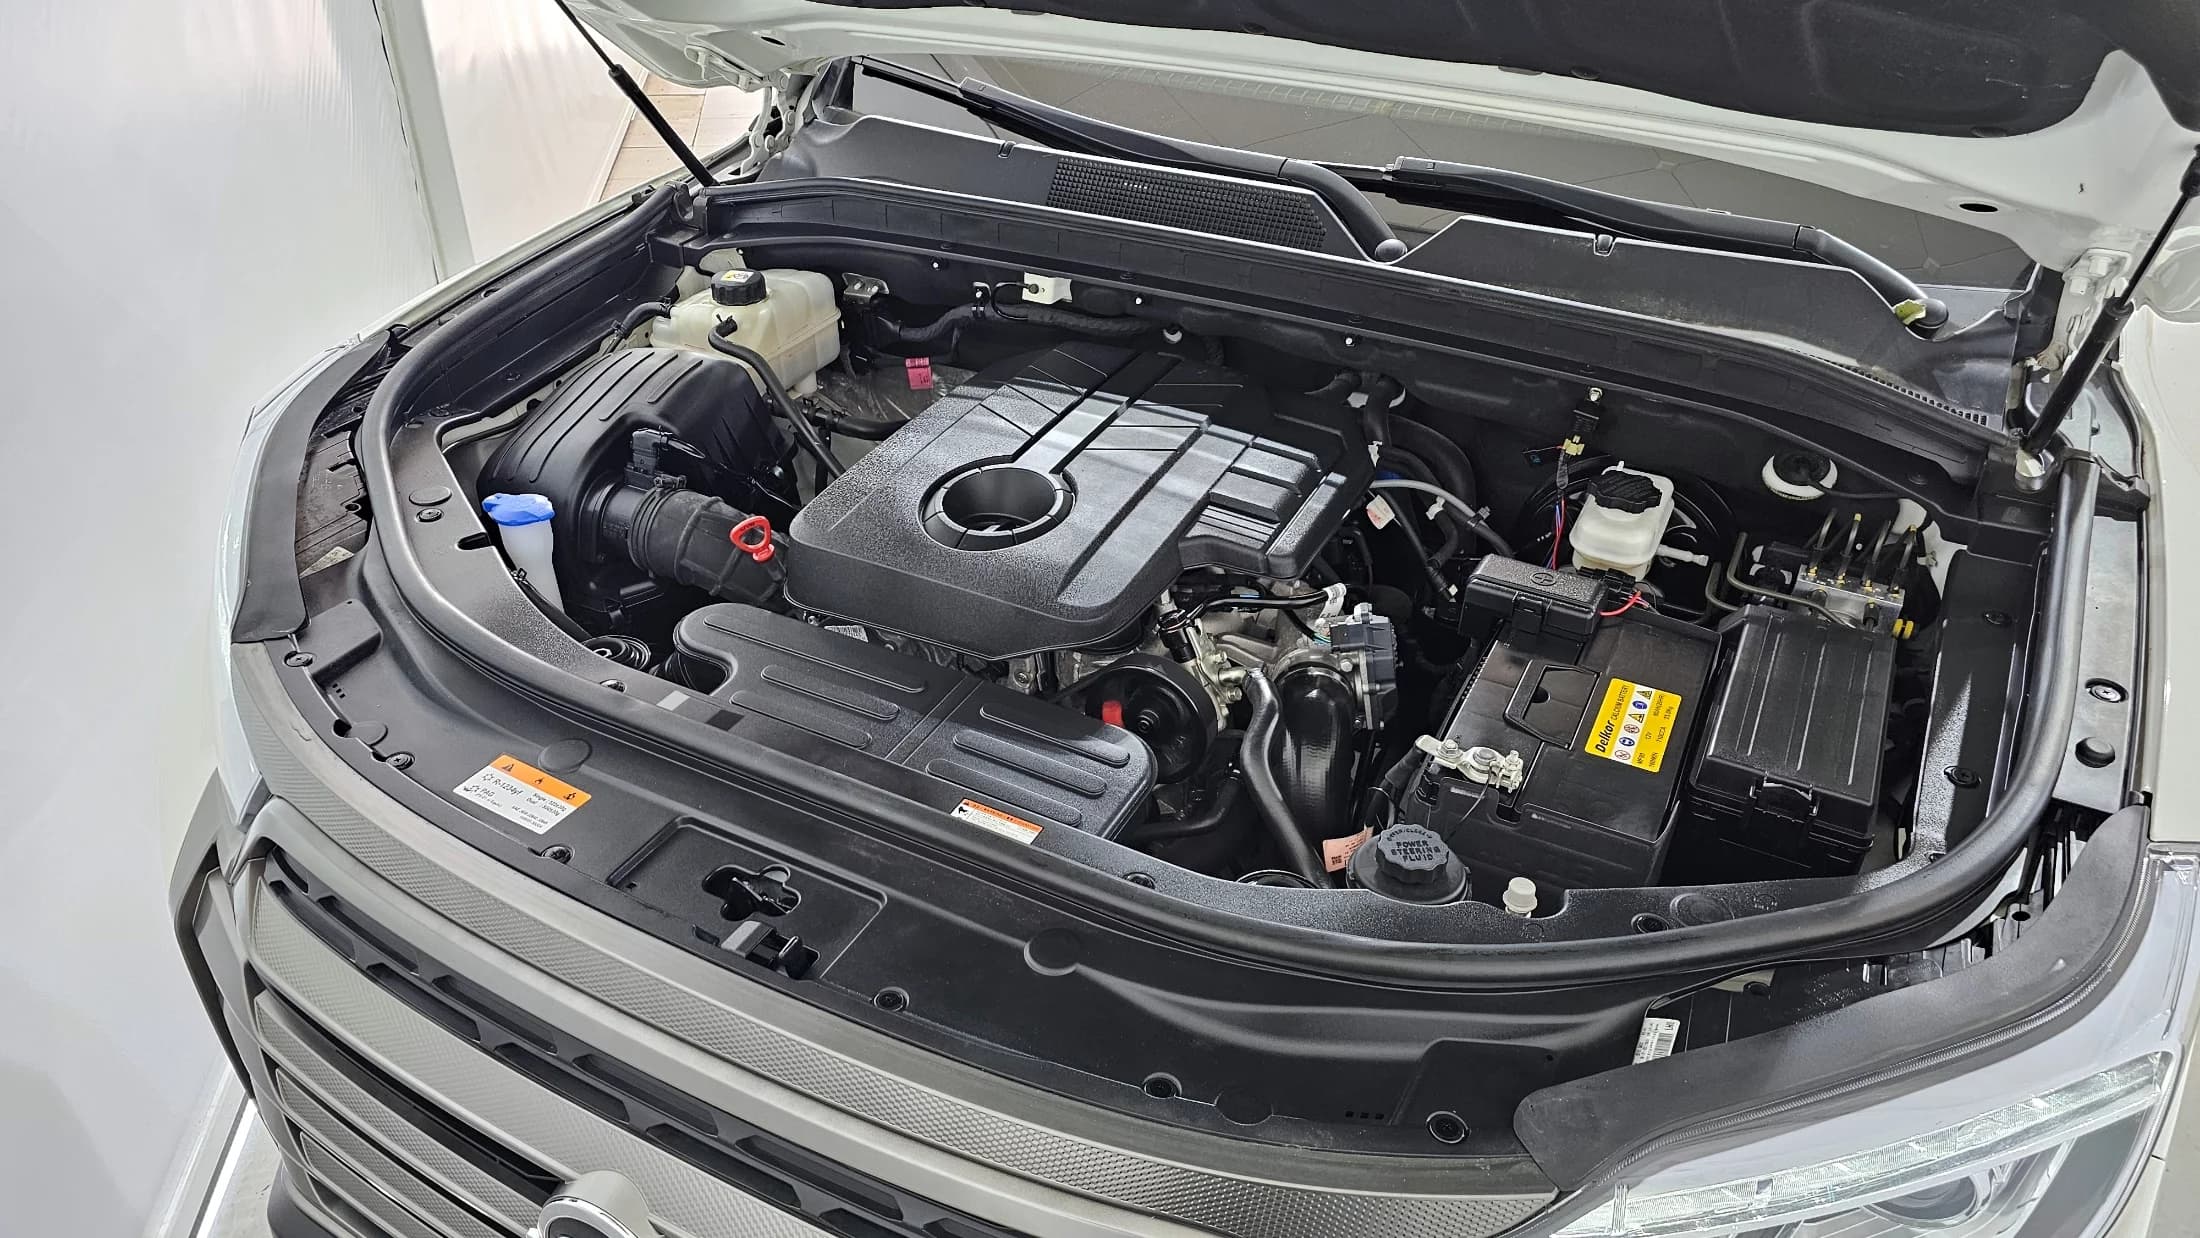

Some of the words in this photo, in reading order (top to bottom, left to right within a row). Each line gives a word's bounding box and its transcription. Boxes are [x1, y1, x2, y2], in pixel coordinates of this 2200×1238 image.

[1595, 720, 1615, 753] Delkor
[493, 778, 524, 796] R-1234yf
[1396, 841, 1429, 849] POWER
[1391, 846, 1441, 856] STEERING
[1402, 854, 1434, 863] FLUID
